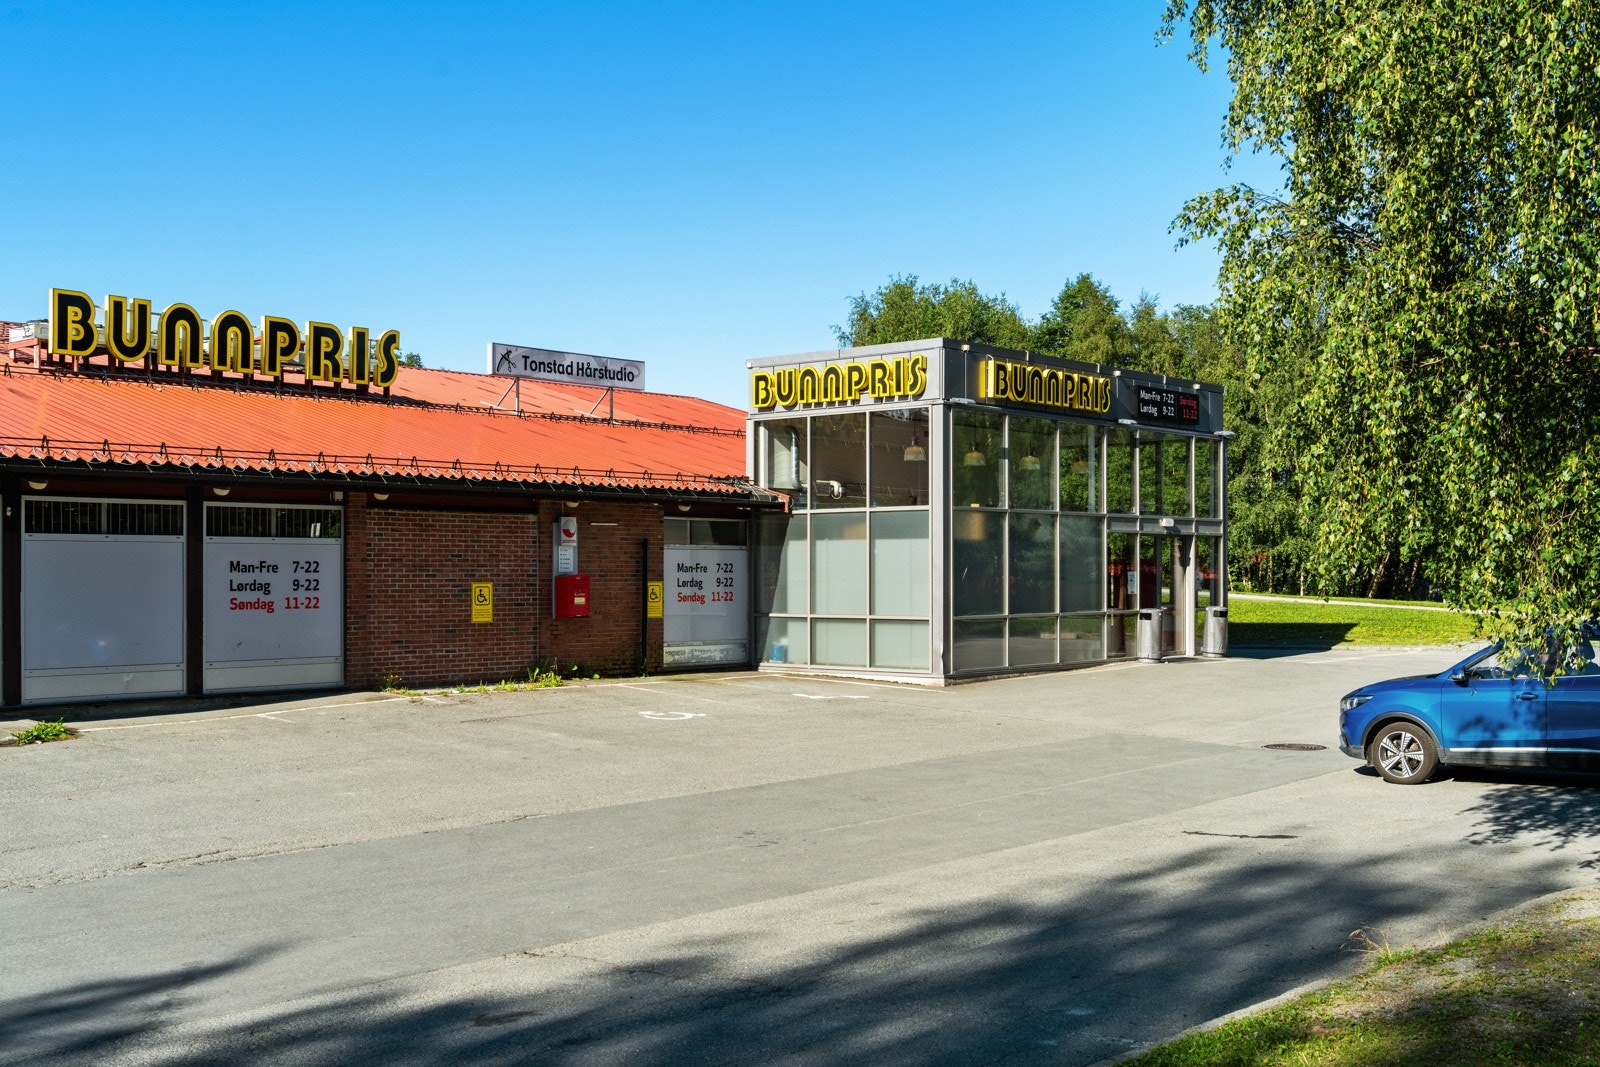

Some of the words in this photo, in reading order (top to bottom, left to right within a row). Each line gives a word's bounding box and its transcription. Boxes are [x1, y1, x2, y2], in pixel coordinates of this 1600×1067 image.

[48, 287, 401, 388] BUNNPRIS
[521, 355, 574, 376] Tonstad
[576, 361, 635, 383] Hårstudio
[752, 354, 927, 409] BUNNPRIS
[989, 360, 1111, 413] BUNNPRIS
[1139, 389, 1161, 402] Man-Fre
[1162, 393, 1175, 404] 7-22
[1162, 405, 1175, 417] 9-22
[229, 560, 279, 574] Man-Fre
[292, 560, 320, 574] 7-22
[677, 562, 708, 573] Man-Fre
[716, 562, 734, 573] 7-22
[229, 579, 271, 596] Lørdag
[292, 579, 320, 592] 9-22
[677, 577, 703, 591] Lørdag
[716, 577, 734, 588] 9-22
[229, 598, 275, 614] Søndag
[284, 596, 320, 610] 11-22
[677, 591, 706, 605] Søndag
[711, 591, 734, 602] 11-22
